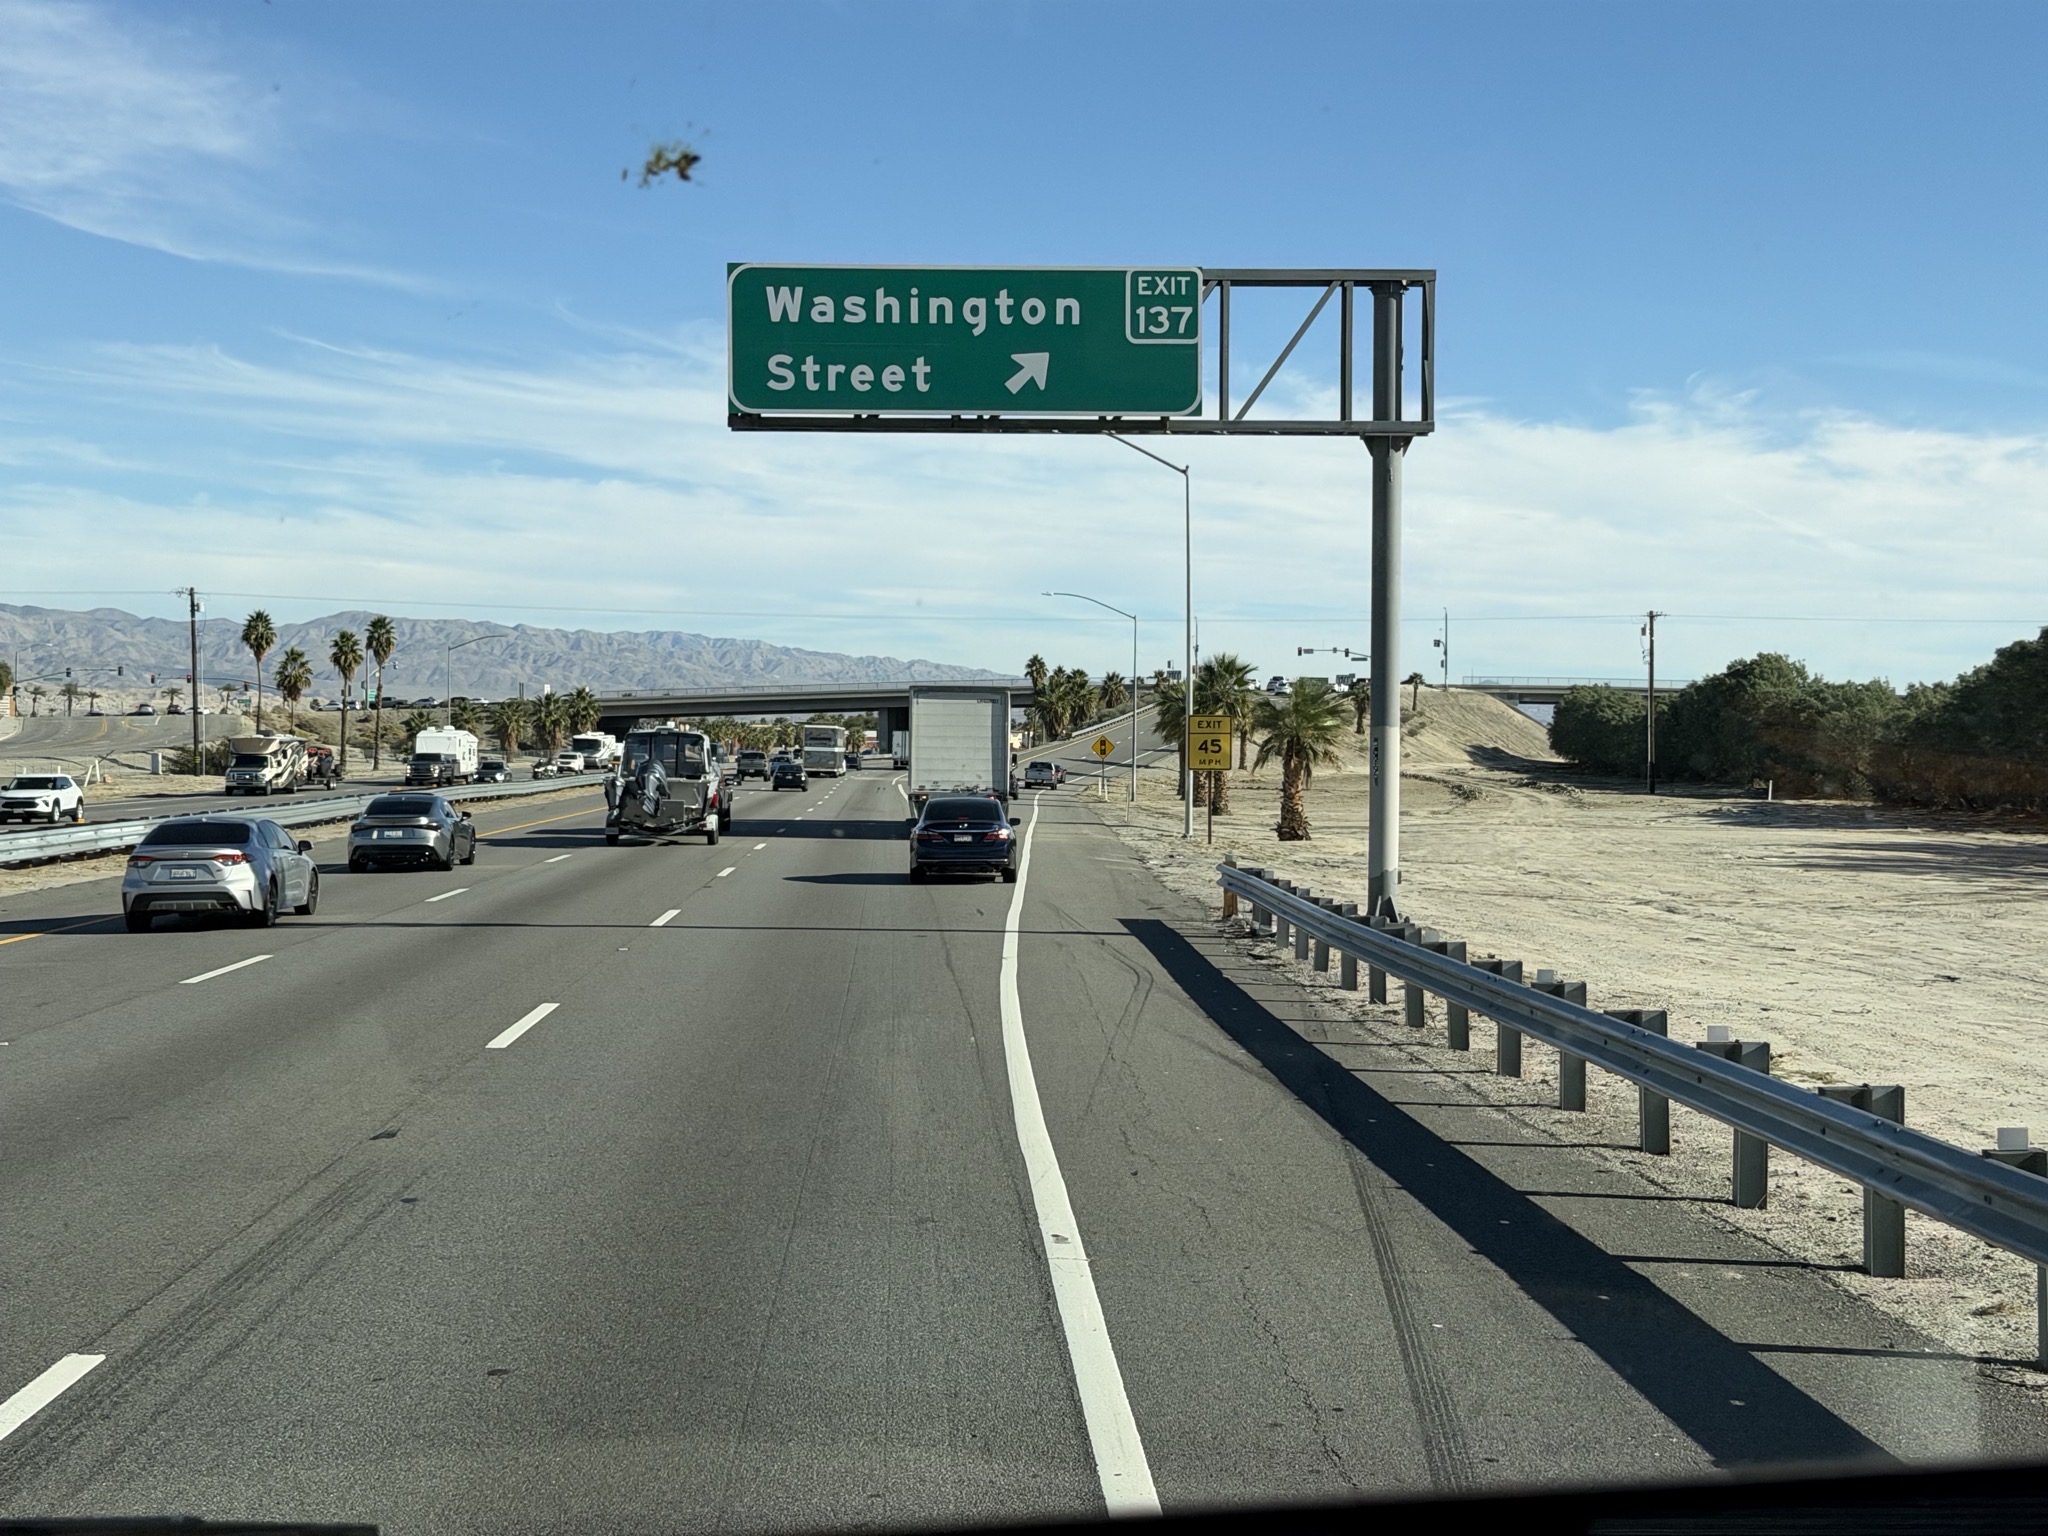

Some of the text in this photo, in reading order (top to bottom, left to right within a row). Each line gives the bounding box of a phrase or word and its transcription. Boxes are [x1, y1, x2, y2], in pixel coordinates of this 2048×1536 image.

[1138, 276, 1191, 296] EXIT
[765, 285, 1081, 337] Washington
[1135, 305, 1193, 334] 137
[766, 354, 932, 392] Street
[1197, 720, 1222, 729] EXIT
[1197, 738, 1222, 754] 45
